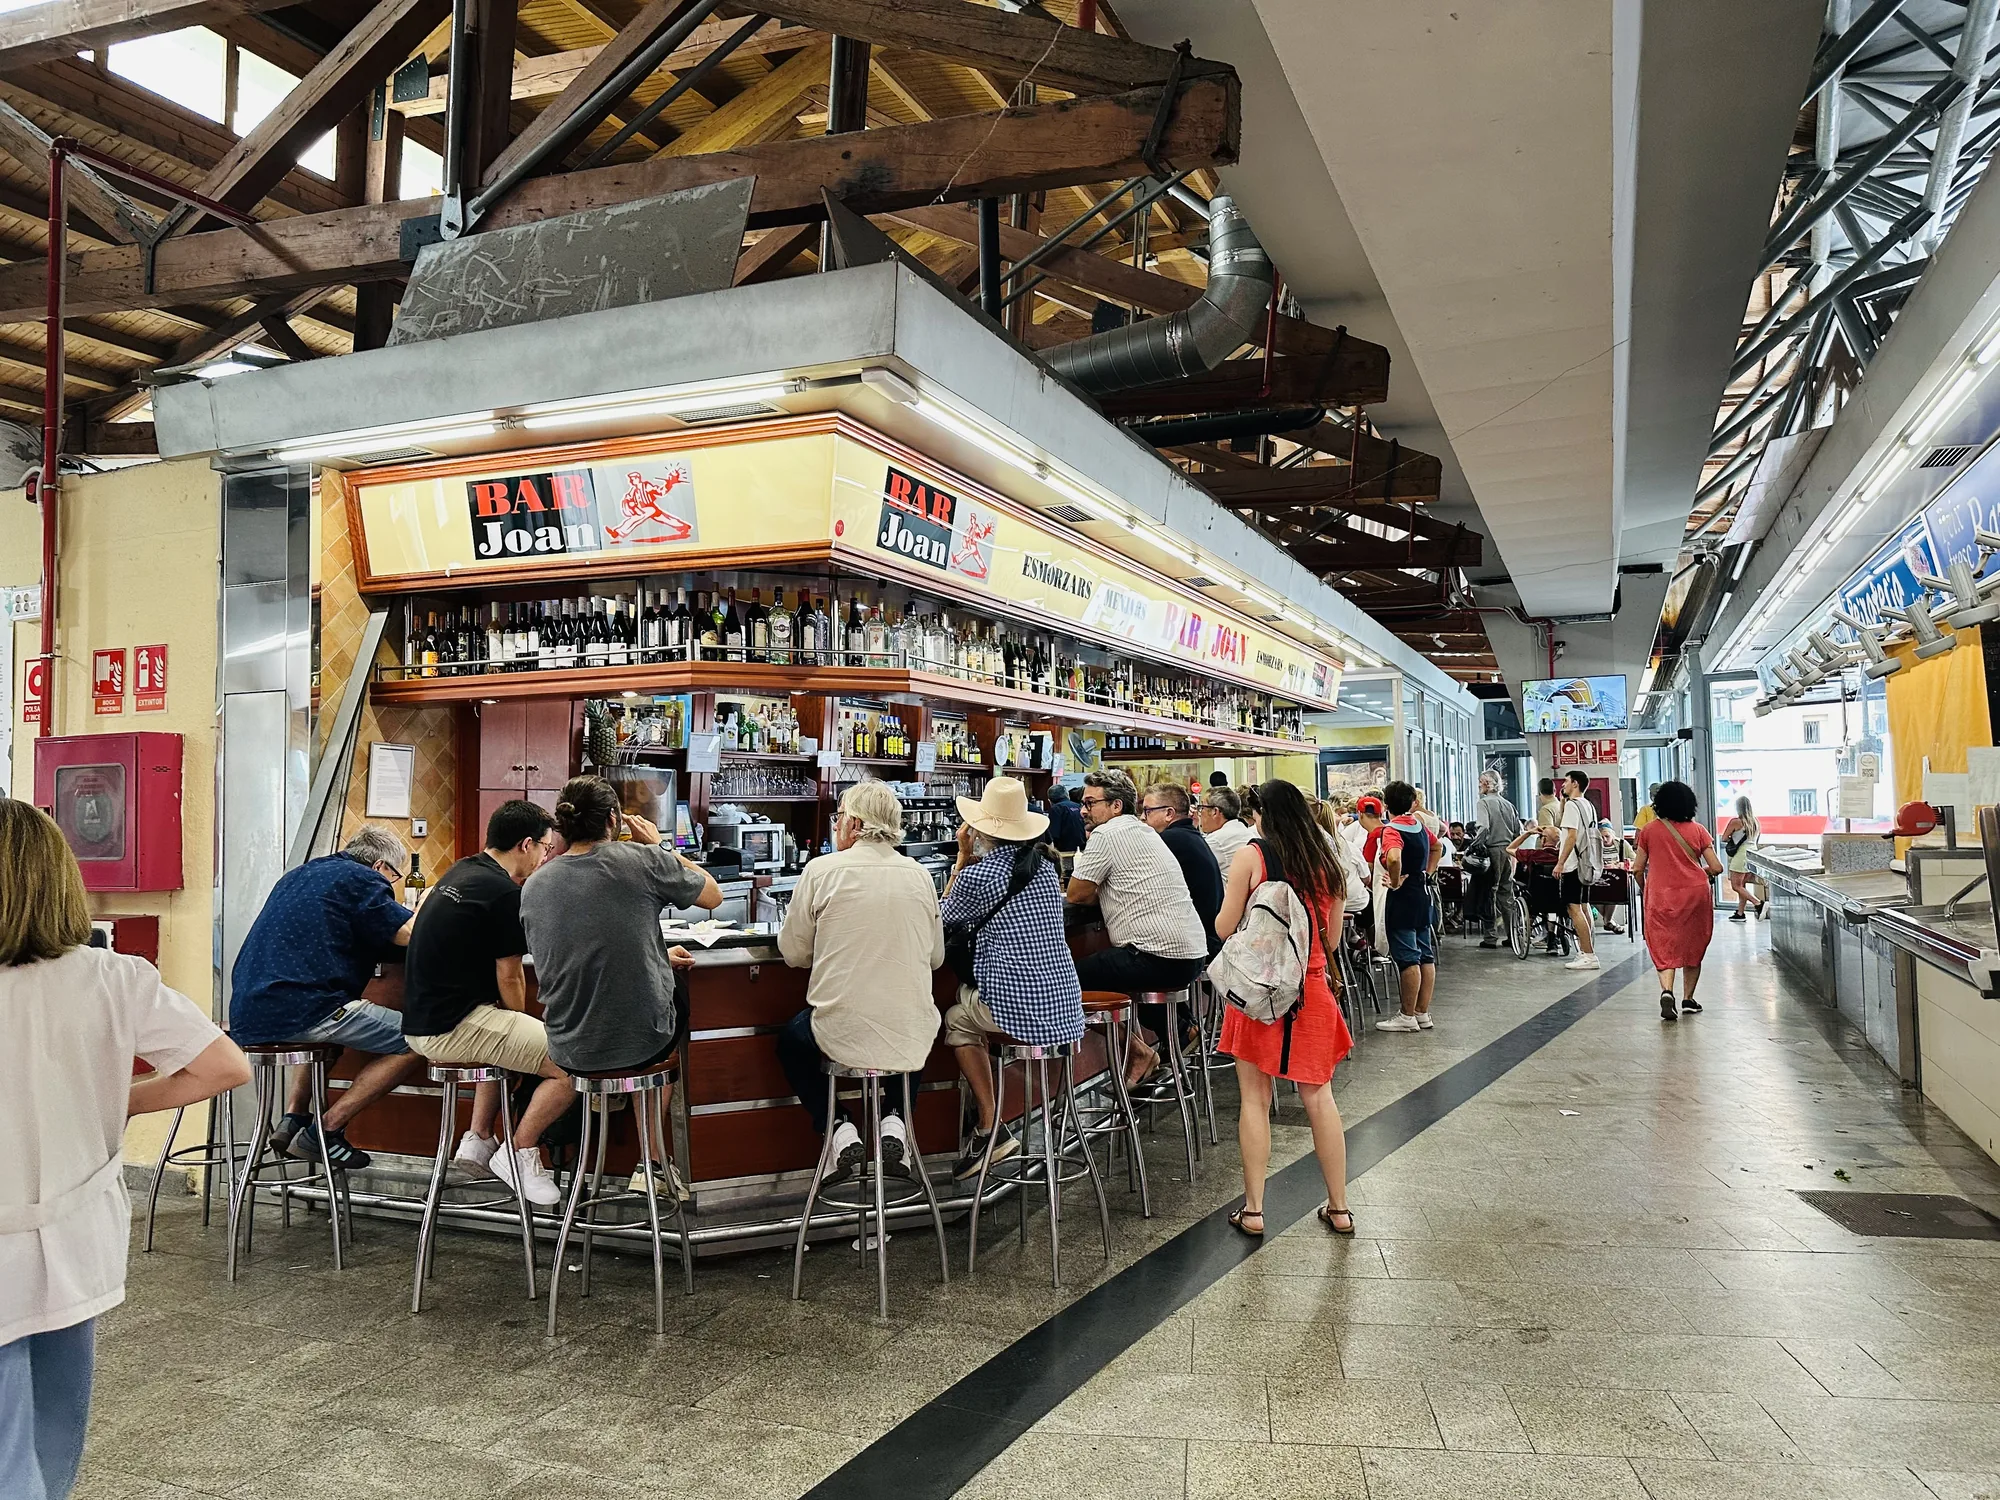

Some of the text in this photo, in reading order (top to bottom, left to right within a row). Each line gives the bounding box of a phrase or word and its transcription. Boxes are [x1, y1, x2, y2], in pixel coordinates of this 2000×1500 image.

[472, 474, 592, 517] BAR
[886, 472, 952, 530] BAR
[478, 521, 598, 556] Joan
[881, 513, 947, 566] Joan
[1021, 555, 1092, 600] ESMORZARS
[25, 705, 41, 713] POLSA
[26, 713, 41, 721] D'INCE
[138, 698, 163, 706] EXTINTOR
